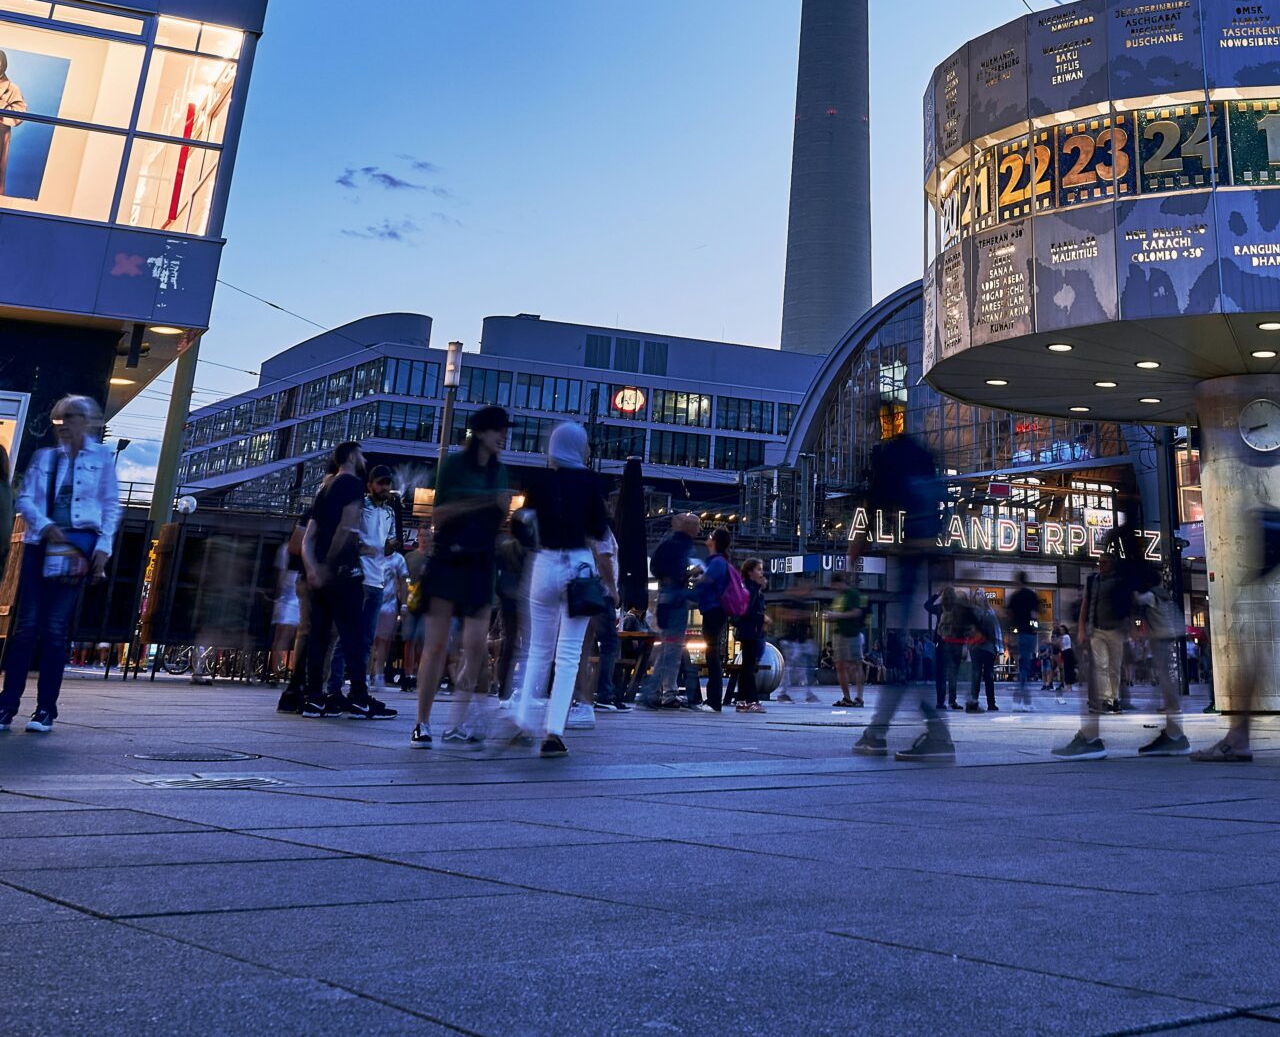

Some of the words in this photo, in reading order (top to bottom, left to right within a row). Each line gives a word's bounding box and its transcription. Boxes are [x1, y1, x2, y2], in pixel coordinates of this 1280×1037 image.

[1115, 0, 1191, 19] JEKATERINBURG
[1235, 5, 1264, 15] OMSK
[1125, 12, 1181, 27] ASCHGABAT
[1222, 26, 1280, 37] TASCHKENT
[1125, 32, 1184, 49] DUSCHANBE
[1056, 50, 1078, 63] BAKU
[1055, 60, 1080, 74] TIFLIS
[1052, 70, 1083, 85] ERIWAN
[1143, 116, 1219, 175] 24
[1062, 127, 1129, 189] 23
[999, 145, 1052, 207] 22
[961, 165, 990, 226] 21
[979, 232, 1009, 249] TEHERAN
[1125, 229, 1147, 241] NEW
[1142, 237, 1192, 251] KARACHI
[1233, 243, 1280, 256] RANGUN
[1052, 247, 1098, 264] MAURITIUS
[1131, 250, 1178, 263] COLOMBO
[989, 264, 1014, 279] SANAA
[981, 278, 1000, 292] ADDIS
[1002, 273, 1025, 286] ABEBA
[990, 320, 1014, 334] KUWAIT
[771, 559, 778, 573] U
[823, 555, 833, 570] U
